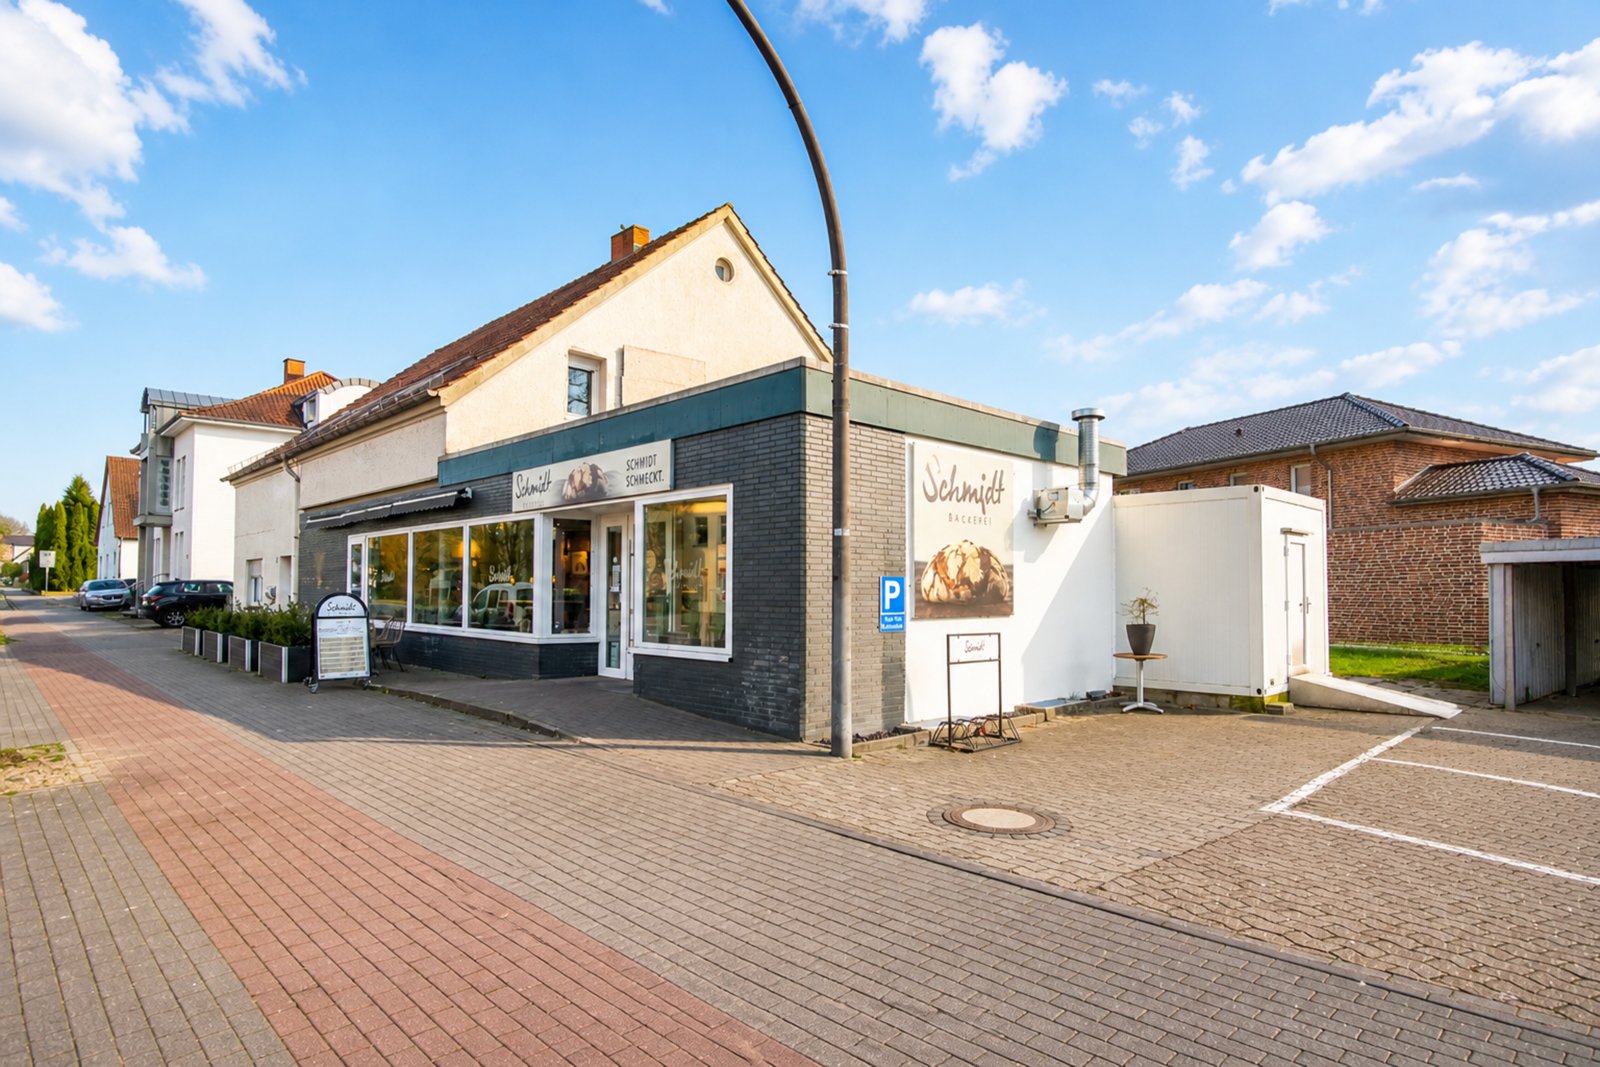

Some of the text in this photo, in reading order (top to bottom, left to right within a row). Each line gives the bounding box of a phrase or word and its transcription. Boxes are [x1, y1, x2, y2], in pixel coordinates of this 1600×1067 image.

[626, 454, 658, 472] SCHMIDT
[515, 468, 552, 499] Schmidt
[626, 469, 665, 488] SCHMECKT.
[922, 453, 1005, 516] Schmidt
[326, 601, 357, 612] Schmidt
[884, 580, 901, 610] P
